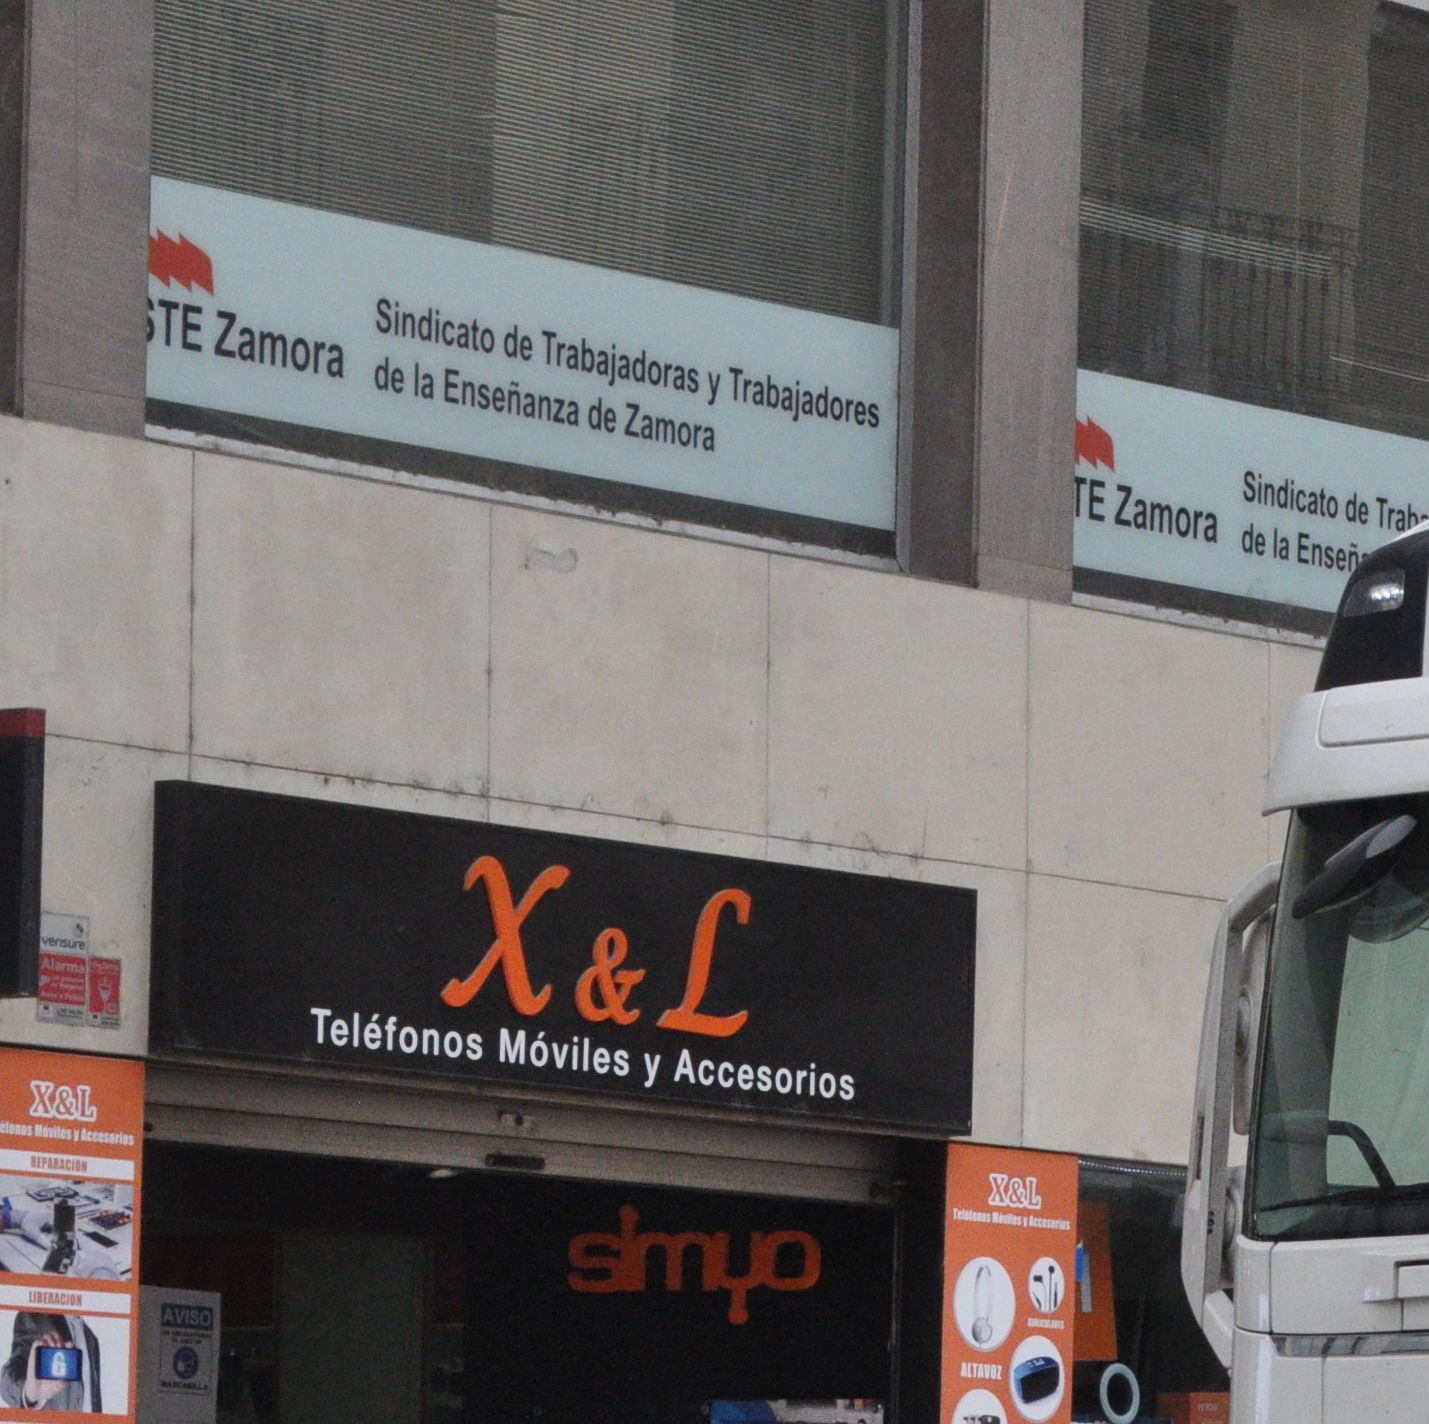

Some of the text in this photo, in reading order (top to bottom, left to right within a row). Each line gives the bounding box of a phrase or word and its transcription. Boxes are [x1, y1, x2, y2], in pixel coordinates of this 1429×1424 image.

[214, 311, 344, 379] Zamora
[376, 298, 880, 428] Sindicato de Trabajadoras y Trabajadores
[374, 357, 715, 452] de la Enseñanza de Zamora
[1115, 485, 1218, 543] Zamora
[1243, 471, 1369, 525] Sindicato de
[1242, 525, 1371, 573] de la Enseñ
[41, 957, 85, 973] Alarma
[440, 855, 752, 1038] X & L
[311, 1007, 855, 1100] Teléfonos Móviles y Accesorios
[29, 1080, 97, 1122] X&L
[81, 1127, 135, 1146] Accesorios
[988, 1173, 1042, 1210] X&L
[953, 1208, 990, 1223] Teléfonos
[1029, 1215, 1071, 1231] Accesorios
[567, 1204, 822, 1325] simyo
[28, 1290, 83, 1307] LIBERACION
[163, 1307, 211, 1327] AVISO
[961, 1362, 1003, 1380] ALTAVOZ
